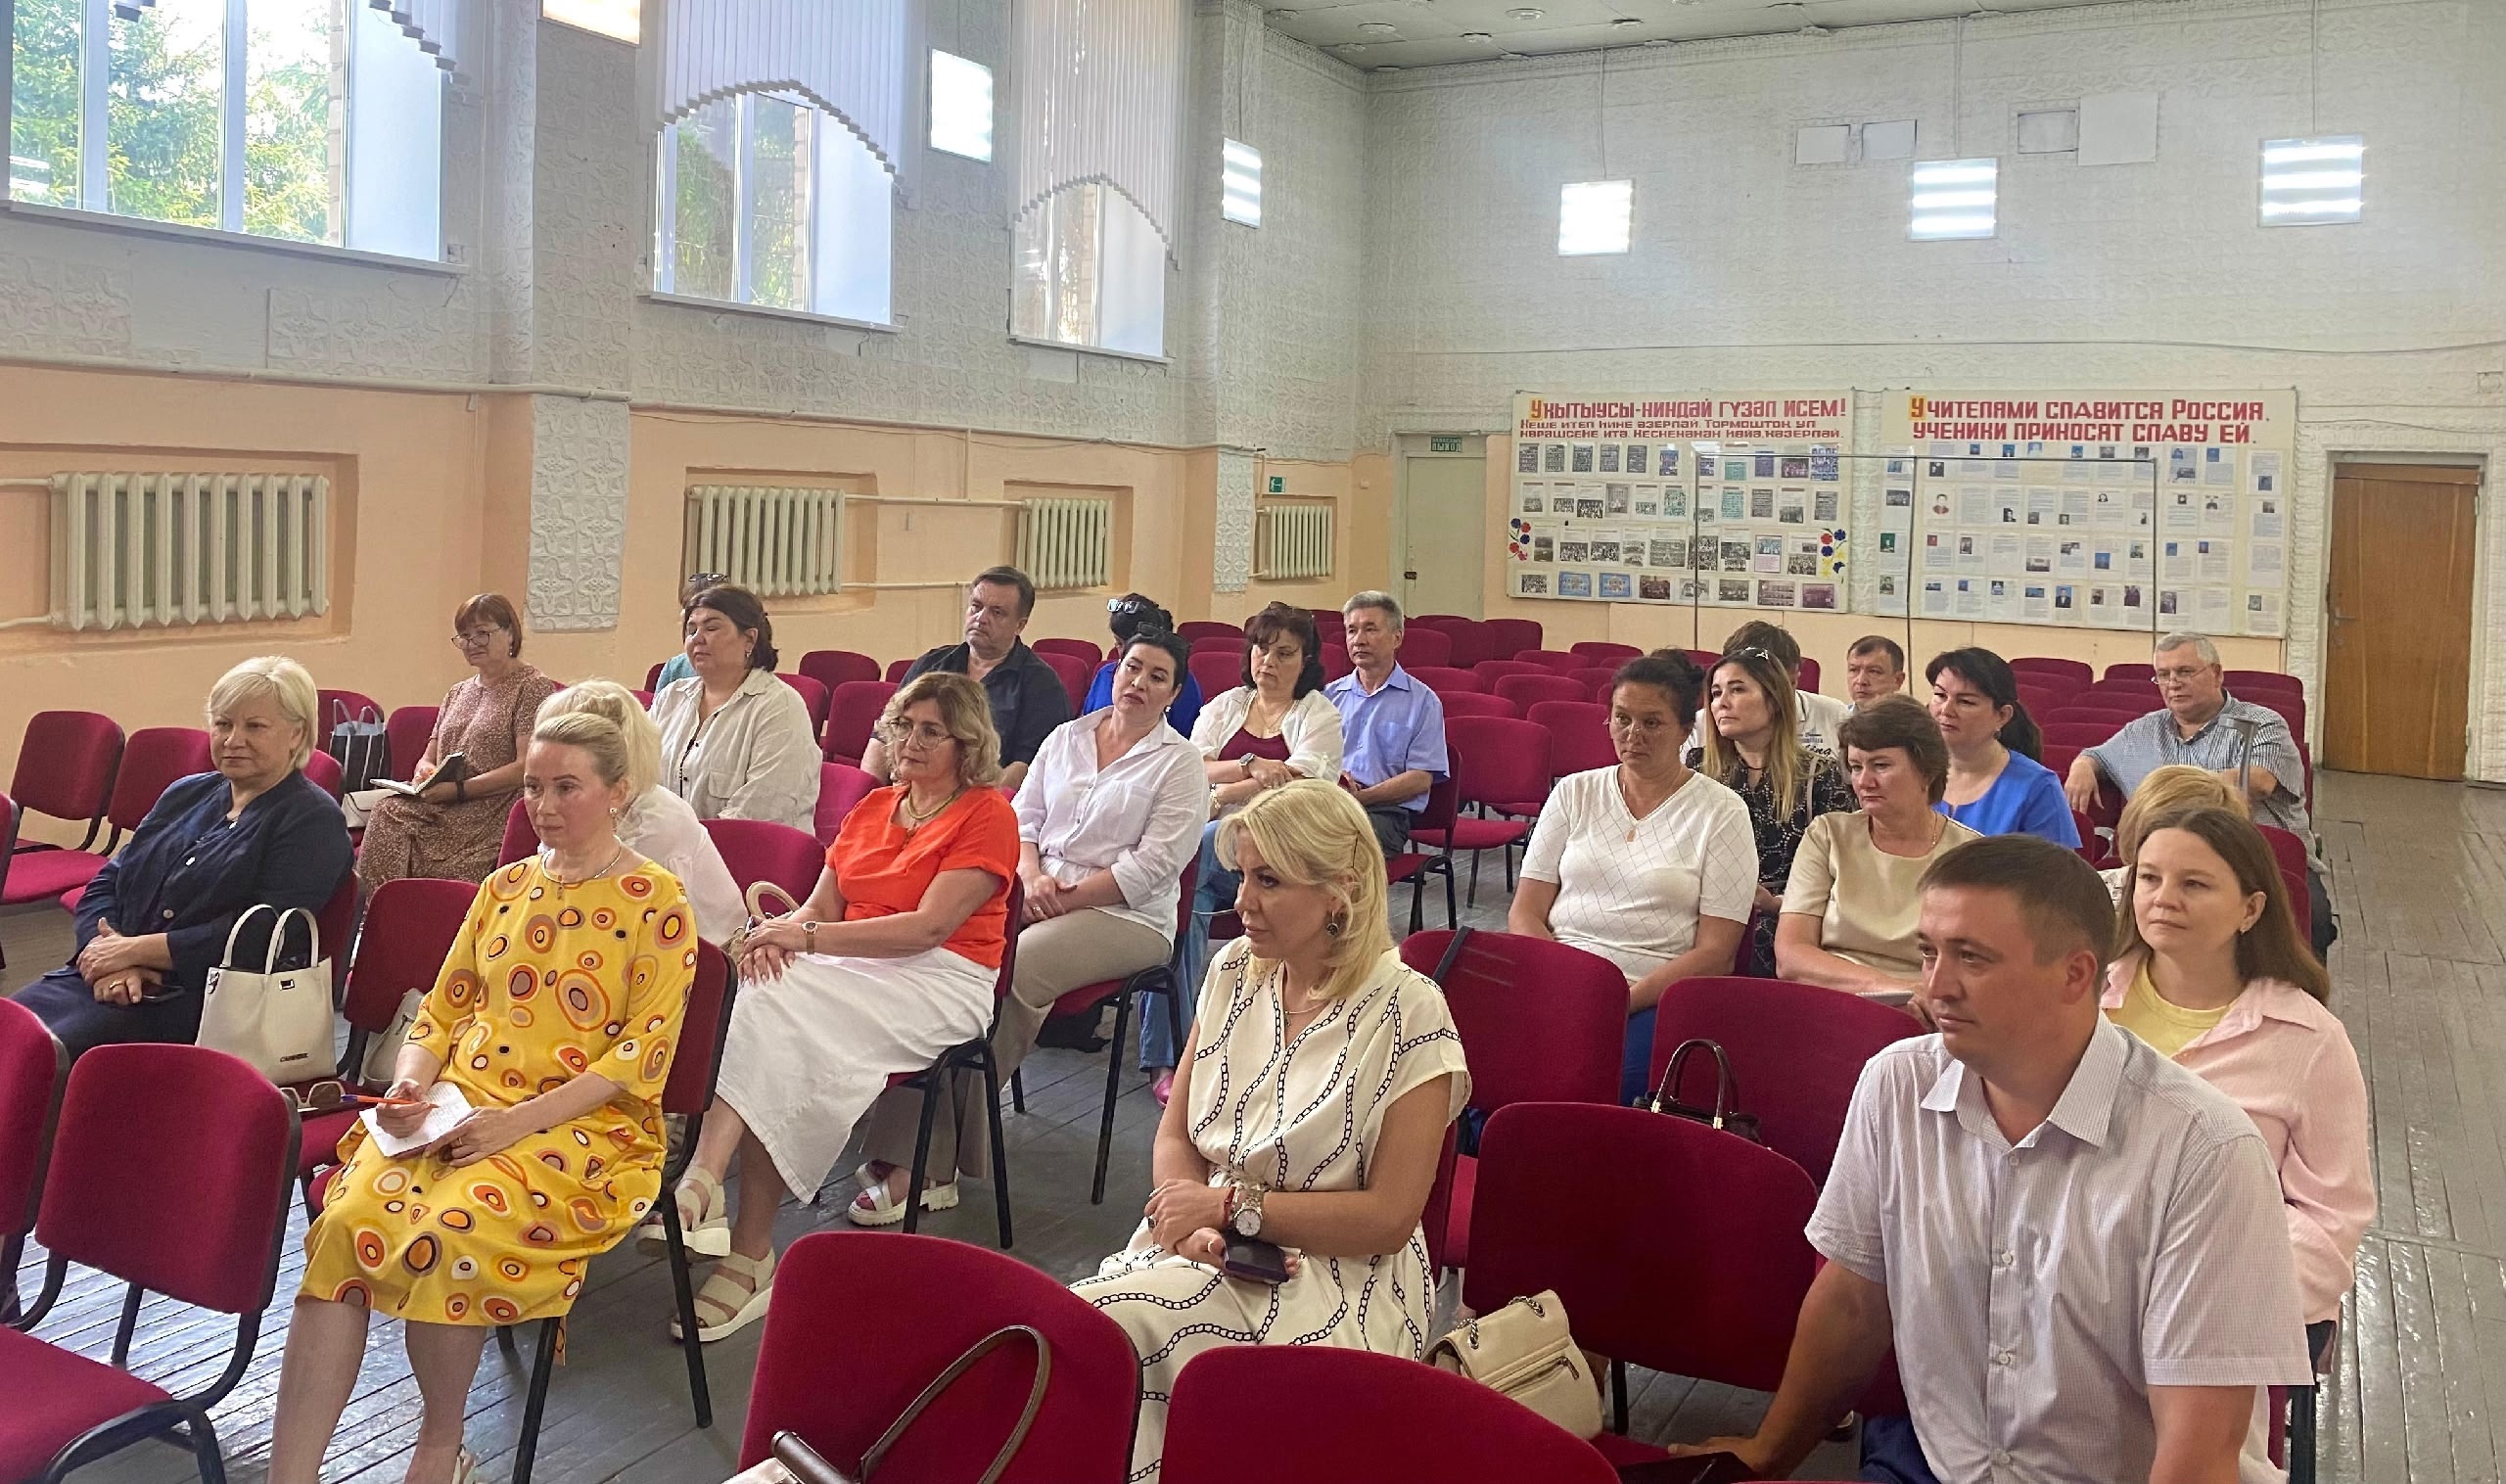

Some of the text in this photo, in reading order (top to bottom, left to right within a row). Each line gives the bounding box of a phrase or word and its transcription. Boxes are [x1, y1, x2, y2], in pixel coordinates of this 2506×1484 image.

[1785, 398, 1846, 417] ИСЕМ!
[1911, 397, 2038, 419] УЧИТЕЛЯМИ
[2046, 400, 2163, 420] СЛАВИТСЯ
[1913, 423, 2007, 441] УЧЕНИКИ
[2014, 423, 2124, 441] ПРИНОСЯТ
[2132, 424, 2208, 442] СЛАВУ
[1432, 442, 1461, 451] ВЫХОД
